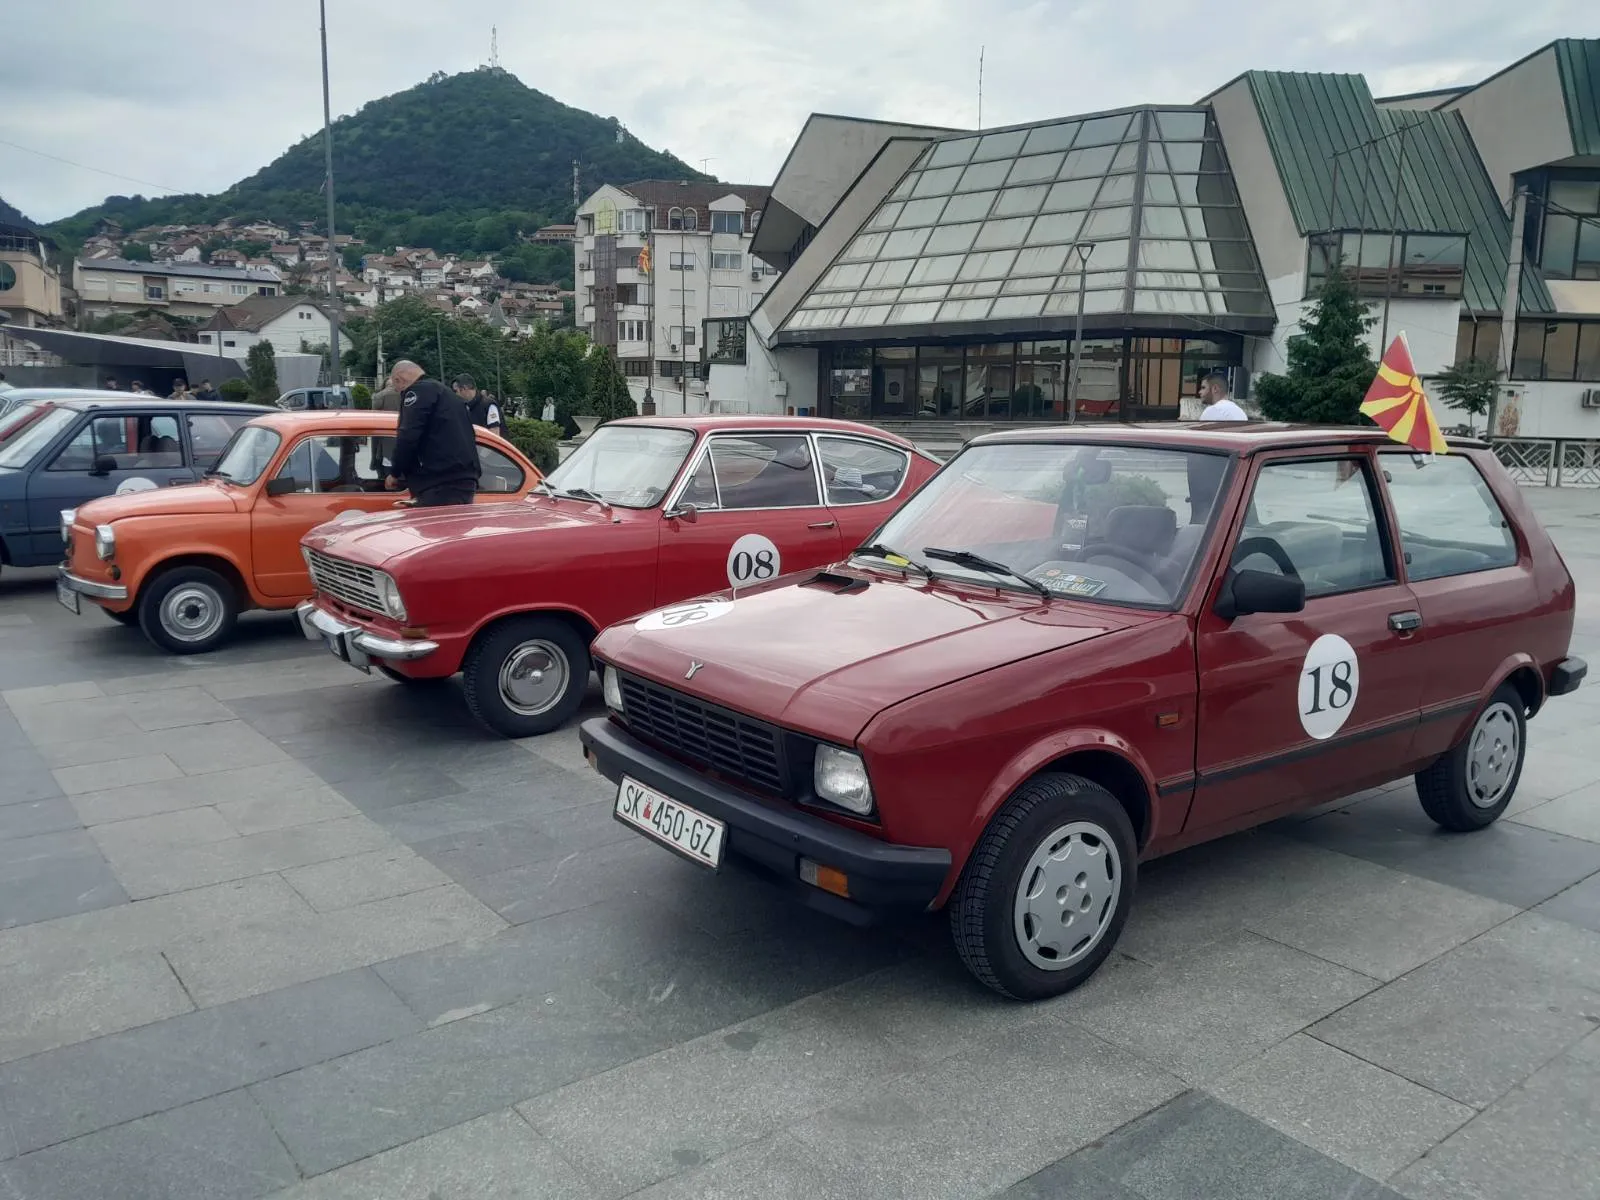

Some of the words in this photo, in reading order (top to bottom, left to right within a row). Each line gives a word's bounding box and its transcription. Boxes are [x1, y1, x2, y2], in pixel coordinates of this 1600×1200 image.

[732, 550, 774, 581] 08
[662, 605, 709, 626] 18
[684, 661, 705, 680] Y
[1304, 661, 1352, 716] 18
[623, 785, 645, 819] SK
